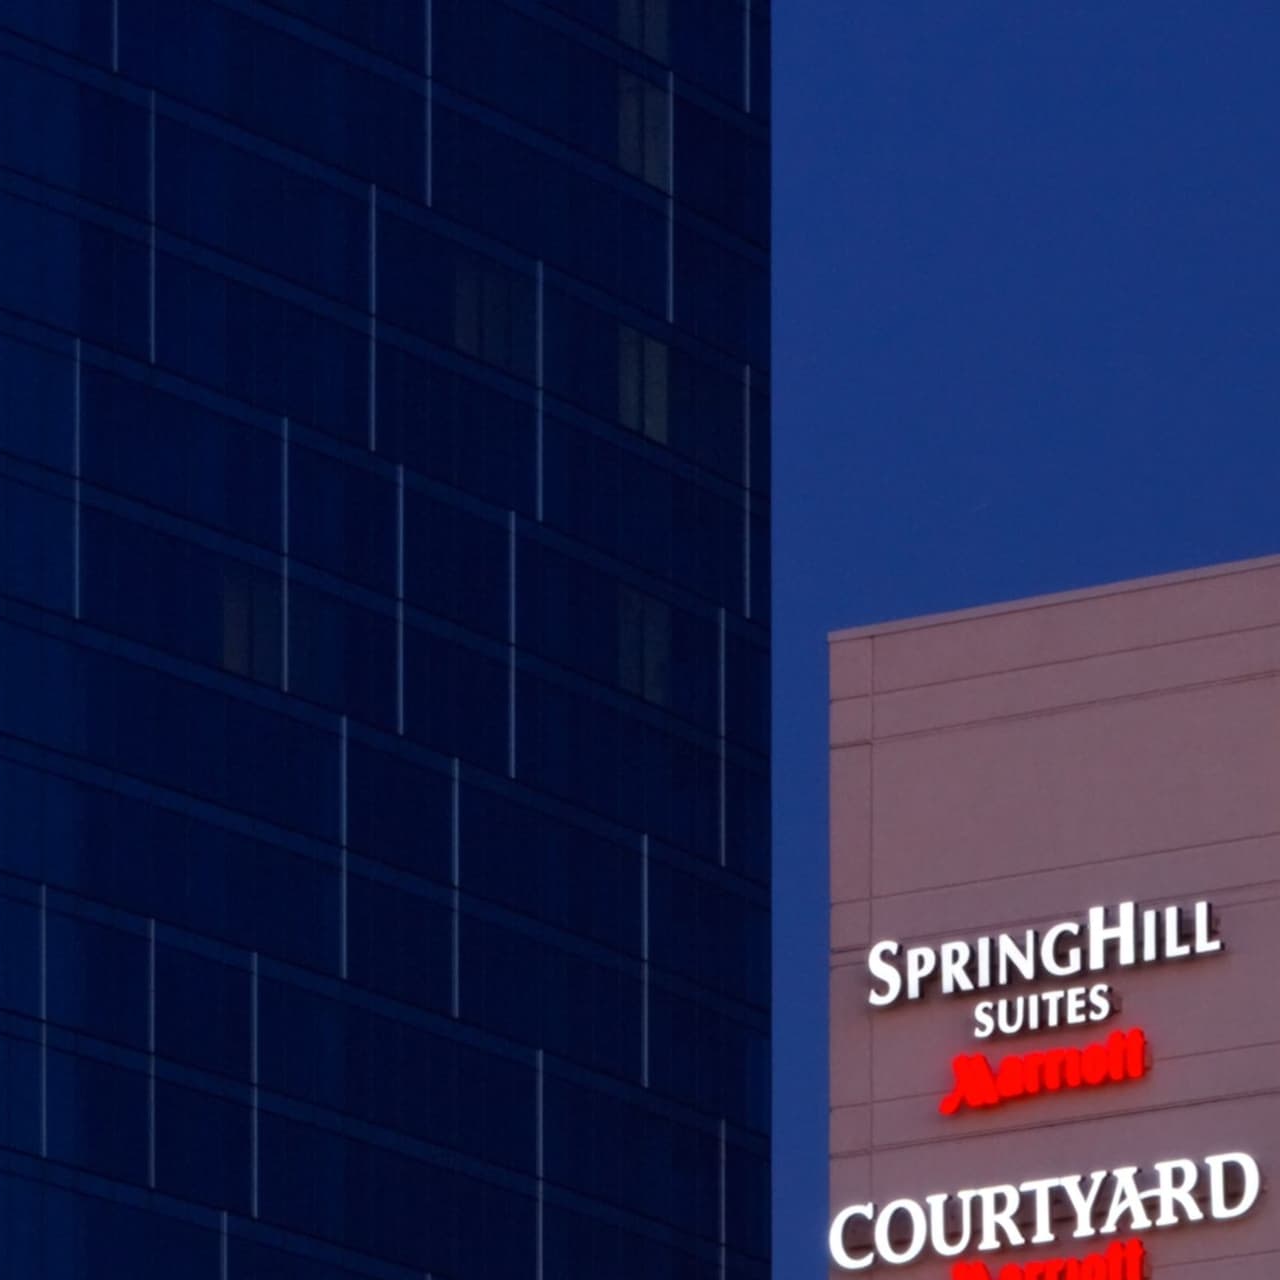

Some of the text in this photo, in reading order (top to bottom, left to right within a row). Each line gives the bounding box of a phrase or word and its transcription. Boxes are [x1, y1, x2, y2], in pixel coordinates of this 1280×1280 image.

[868, 900, 1223, 1006] SPRINGHILL
[974, 984, 1111, 1038] SUITES
[939, 1026, 1146, 1115] Marriott
[828, 1151, 1261, 1270] COURTYARD
